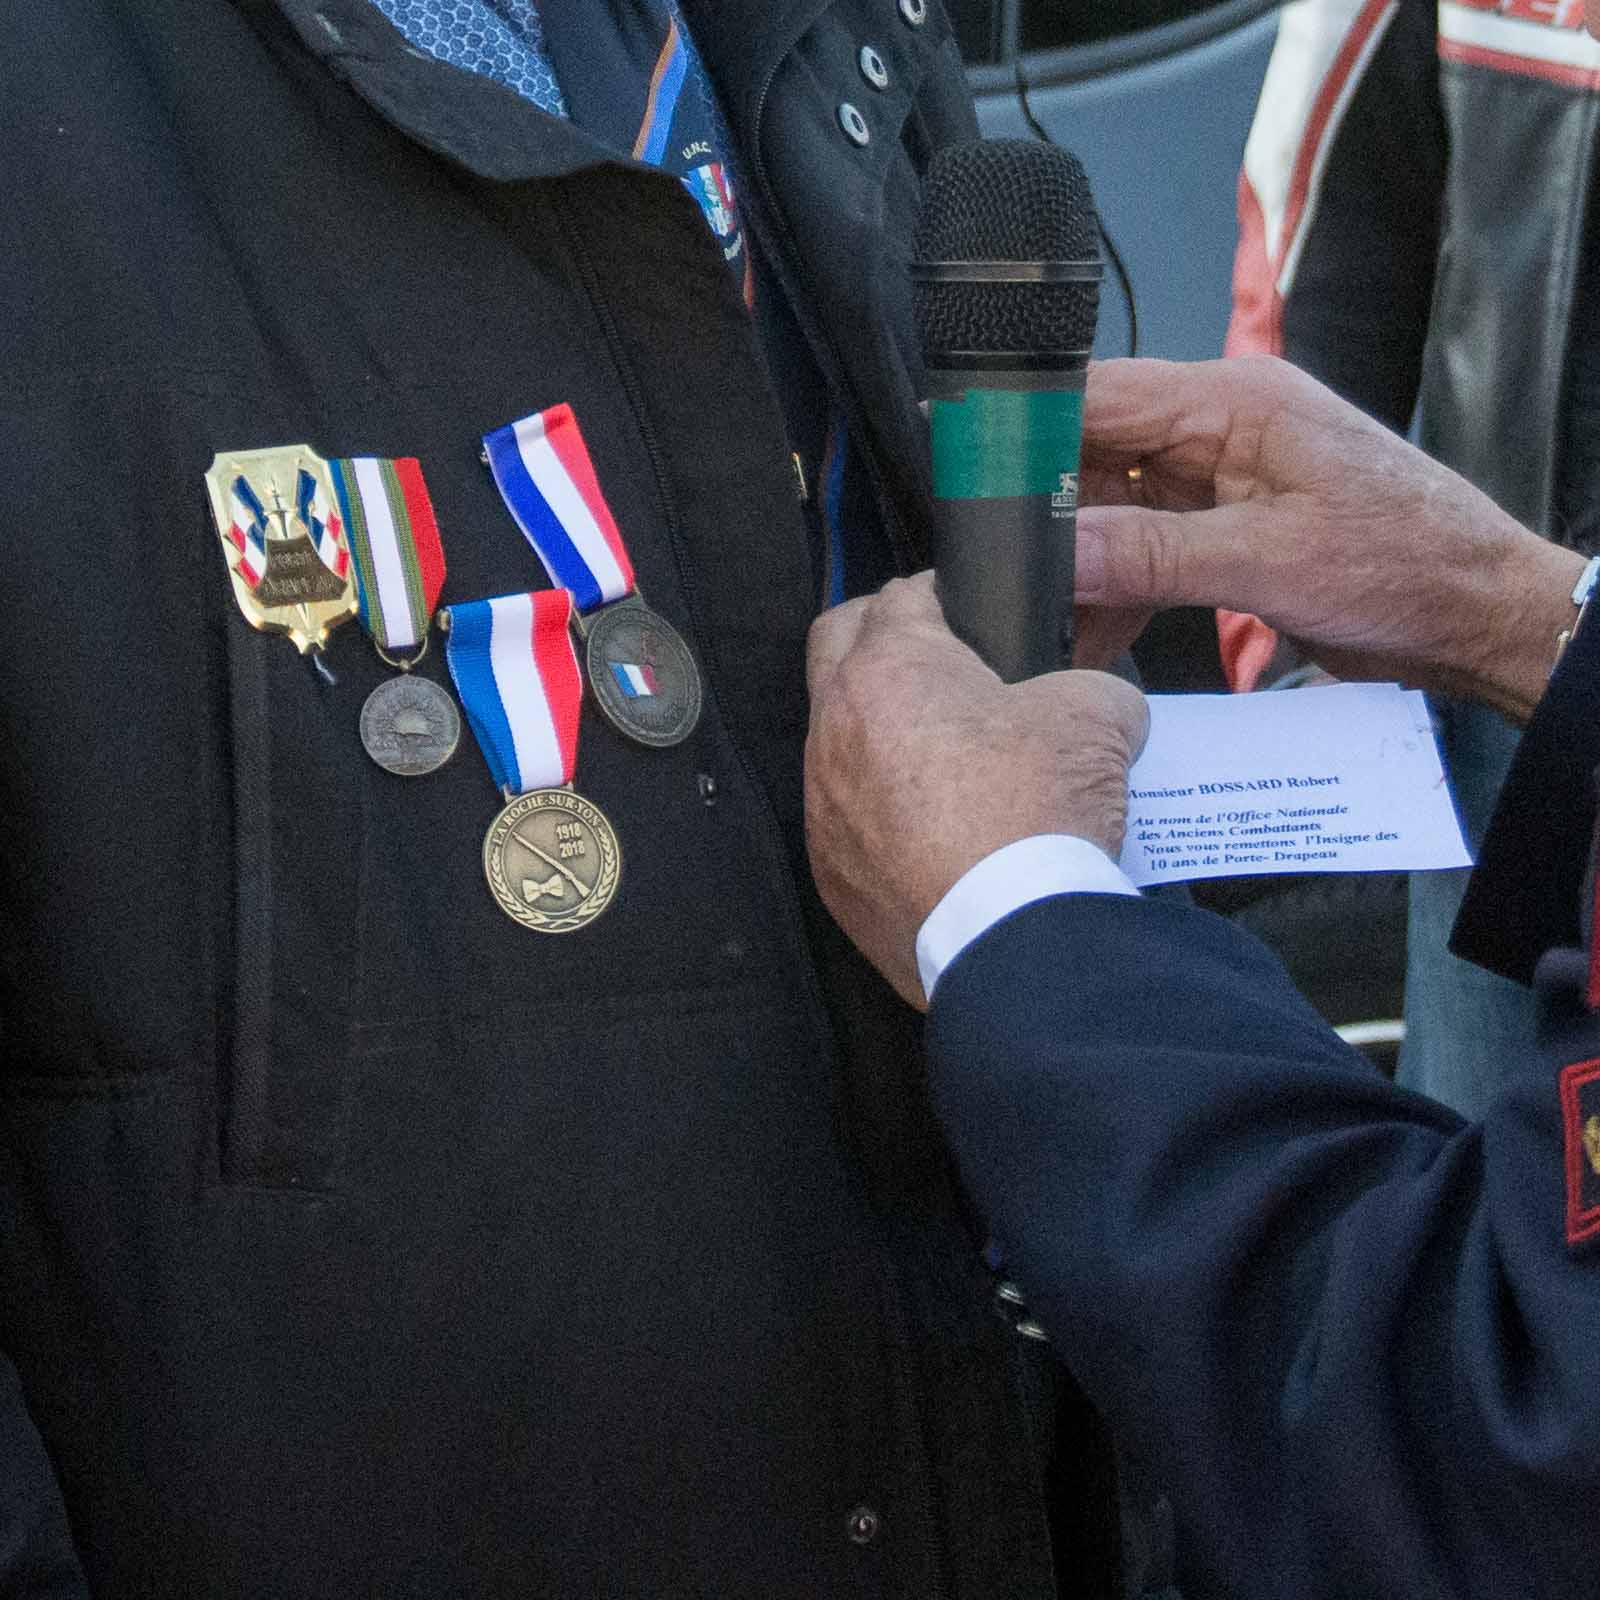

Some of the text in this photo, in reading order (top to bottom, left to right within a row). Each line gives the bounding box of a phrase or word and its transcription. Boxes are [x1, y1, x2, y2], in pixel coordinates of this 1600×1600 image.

[1198, 778, 1282, 795] BOSSARD
[1286, 775, 1340, 788] Robert
[1133, 804, 1348, 827] Au nom de l'Office Nationale
[556, 822, 582, 840] 1918
[1137, 821, 1322, 841] des Anciens Combattants
[559, 840, 585, 859] 2018
[1143, 831, 1399, 856] Nous vous remettons l'Insigne des
[1151, 859, 1167, 871] 10
[1171, 858, 1198, 868] ans
[1203, 855, 1219, 865] de
[1274, 850, 1337, 862] Drapeau
